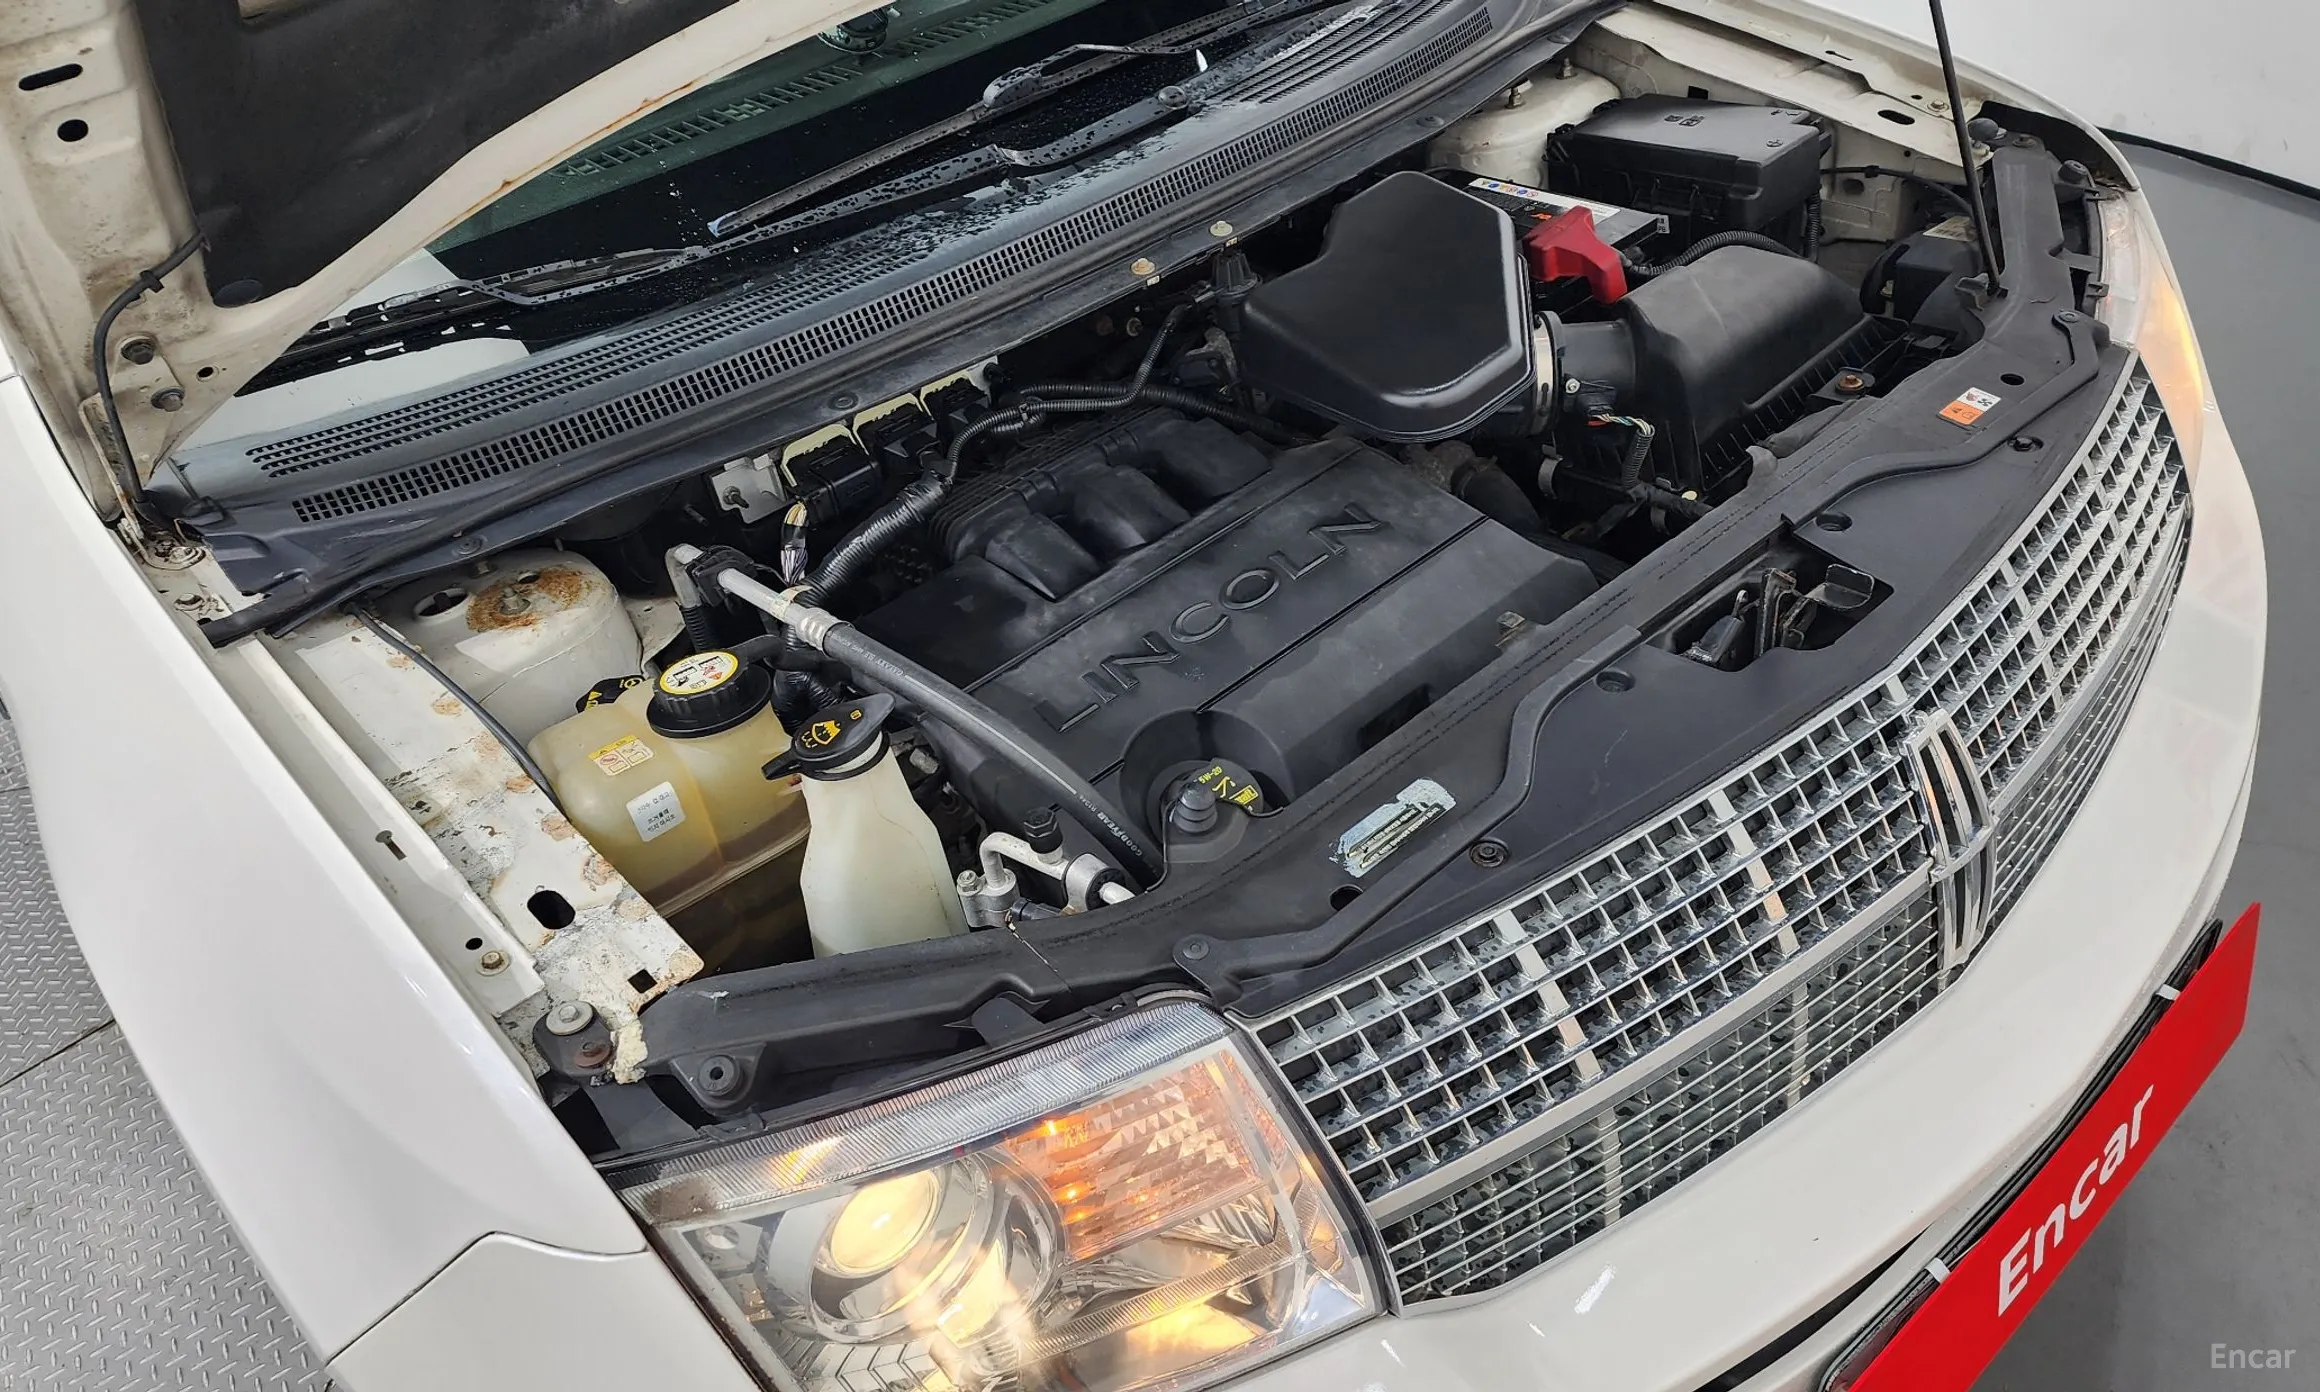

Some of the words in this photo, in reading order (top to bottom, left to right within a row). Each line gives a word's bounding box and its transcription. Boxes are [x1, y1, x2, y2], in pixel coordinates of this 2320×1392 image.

[1033, 502, 1384, 733] LINCOLN
[1097, 811, 1143, 857] GOODYEAR
[1198, 766, 1222, 784] 5W-20
[1998, 1084, 2154, 1317] Encar
